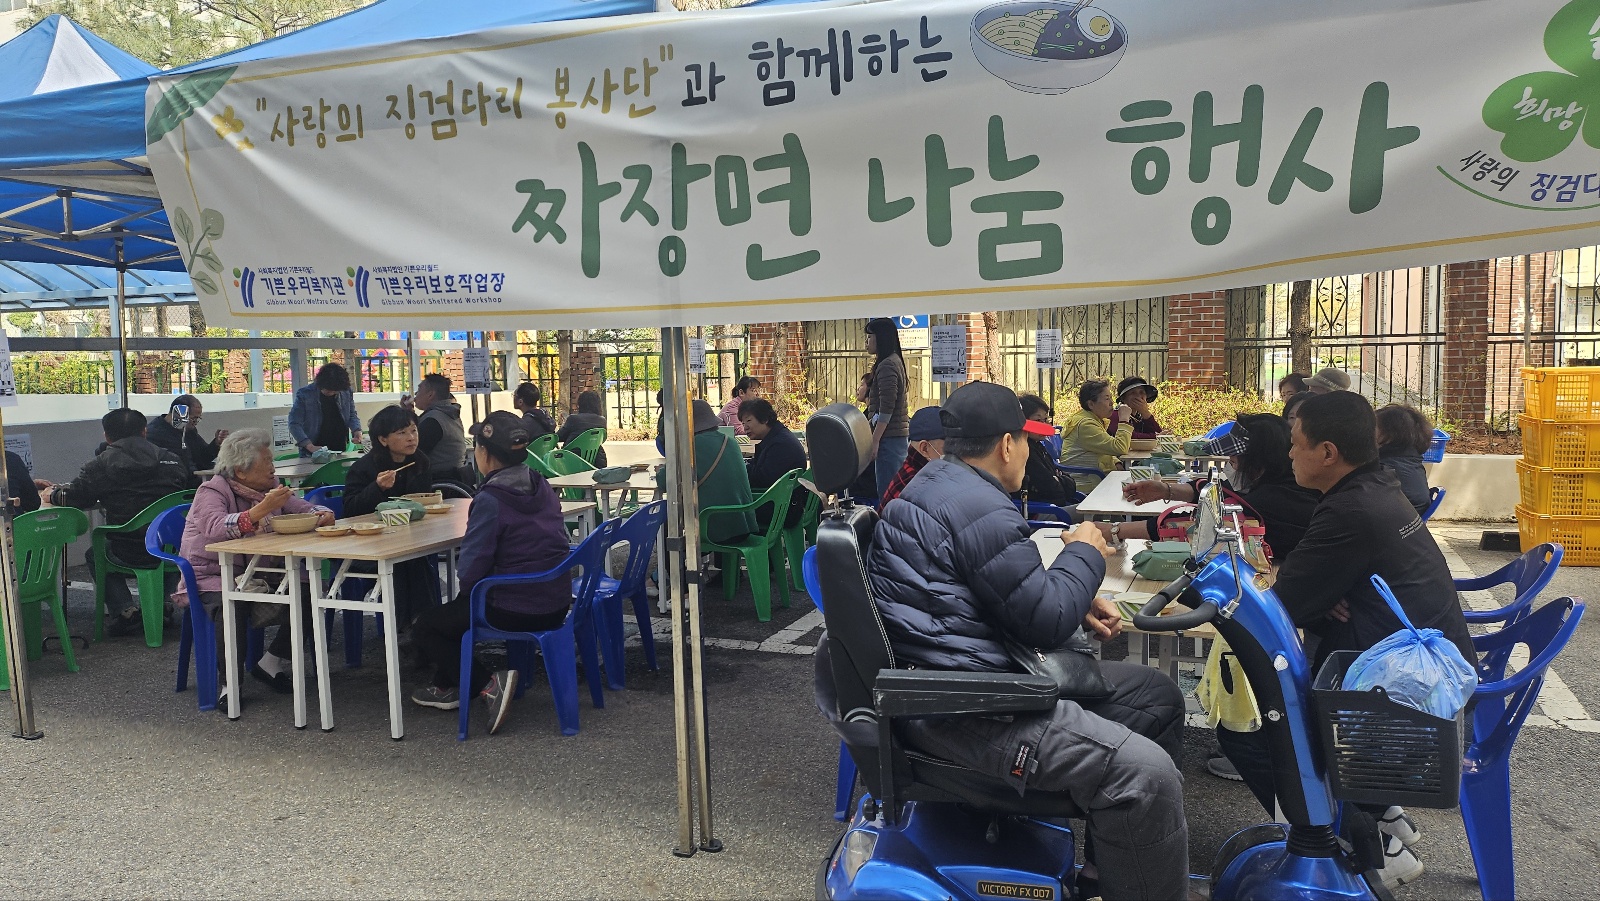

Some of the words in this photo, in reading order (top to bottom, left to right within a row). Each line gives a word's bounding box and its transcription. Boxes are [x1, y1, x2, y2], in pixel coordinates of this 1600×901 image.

[386, 77, 523, 141] 징검다리
[748, 15, 953, 107] 함께하는
[1513, 86, 1583, 131] 희망
[512, 132, 821, 281] 짜장면
[868, 114, 1065, 281] 나눔
[1106, 81, 1421, 246] 행사
[1459, 150, 1520, 192] 사랑의
[260, 276, 346, 296] 기쁜우리복지관
[375, 272, 505, 296] 기쁜우리보호작업장
[428, 297, 463, 305] Sheltered
[465, 296, 502, 304] Workshop
[981, 883, 1018, 896] VICTORY
[1019, 887, 1031, 897] FX
[1033, 888, 1050, 899] 007
